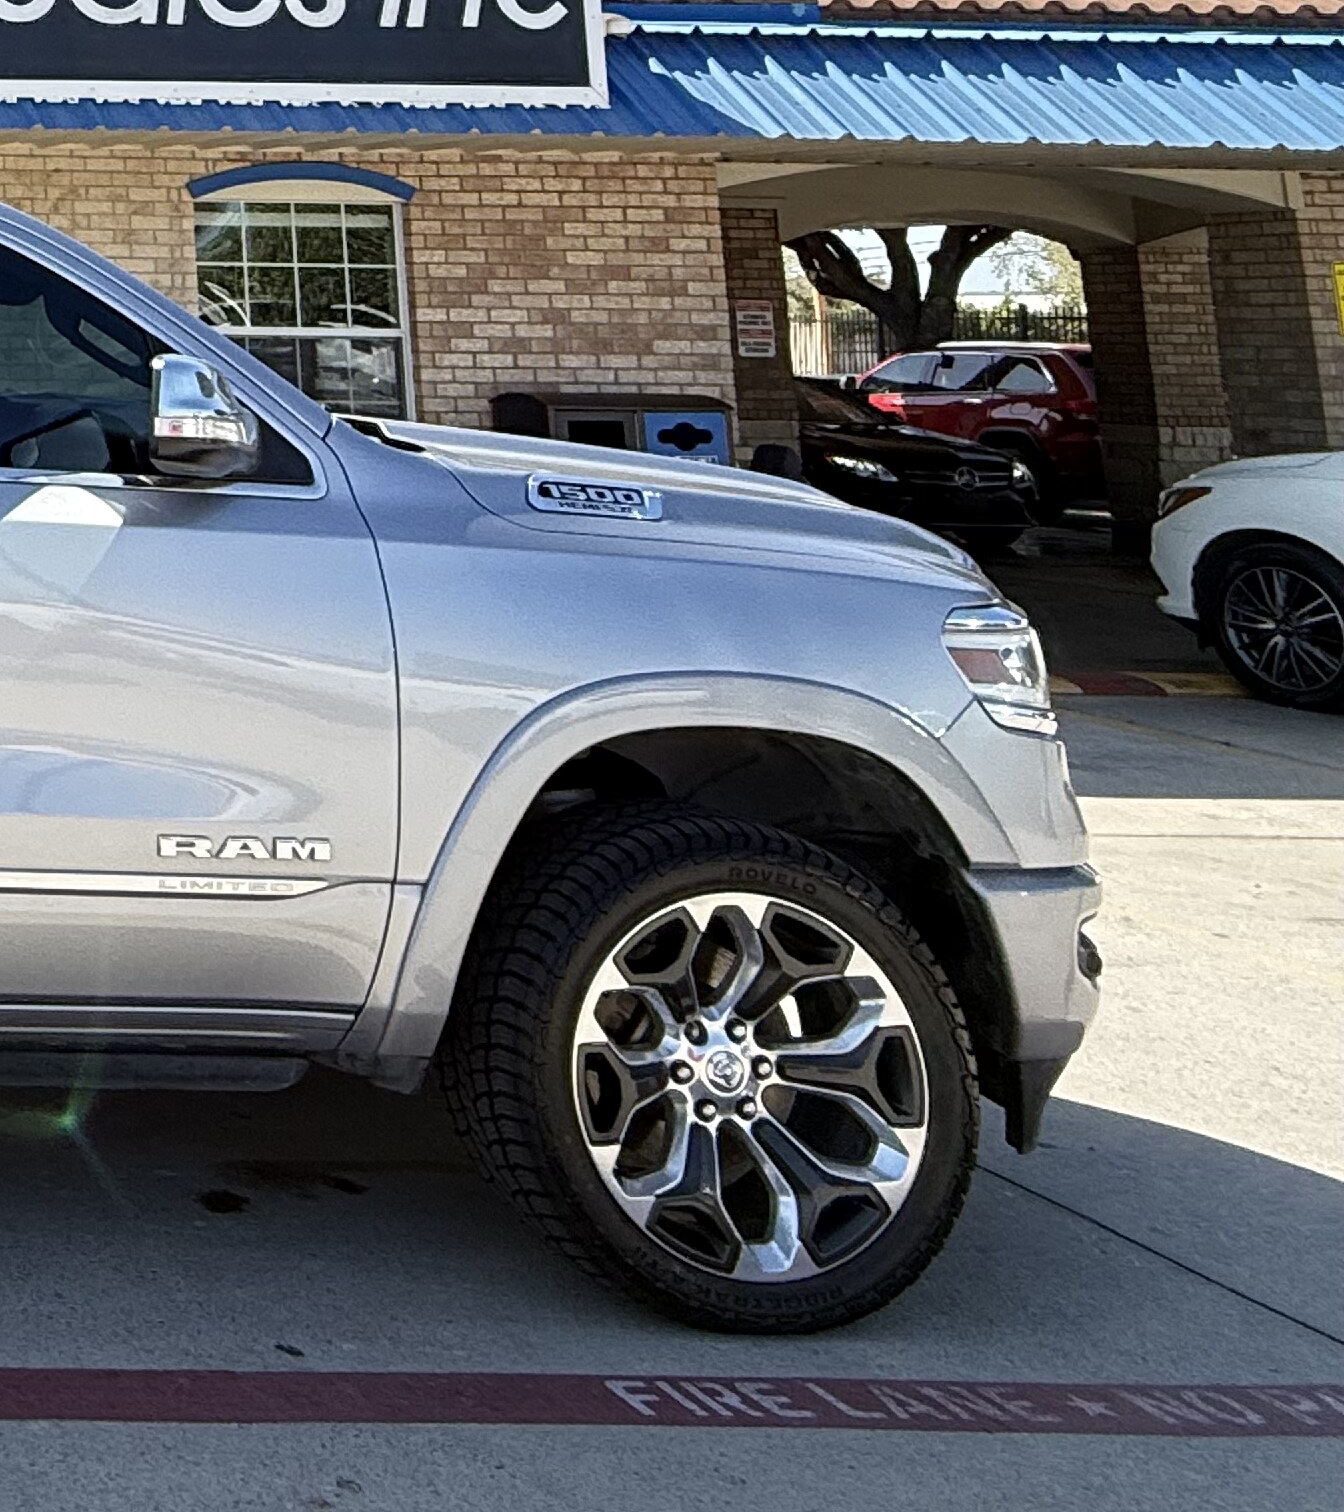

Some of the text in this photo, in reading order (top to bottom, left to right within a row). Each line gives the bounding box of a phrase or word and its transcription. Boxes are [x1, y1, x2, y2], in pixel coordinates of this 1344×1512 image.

[541, 483, 642, 505] 1500
[158, 834, 331, 861] RAM
[159, 879, 294, 892] LIMITED
[728, 866, 817, 895] ROVELO
[604, 1380, 816, 1418] FIRE
[808, 1382, 1062, 1422] LANE
[1115, 1389, 1266, 1425] NO
